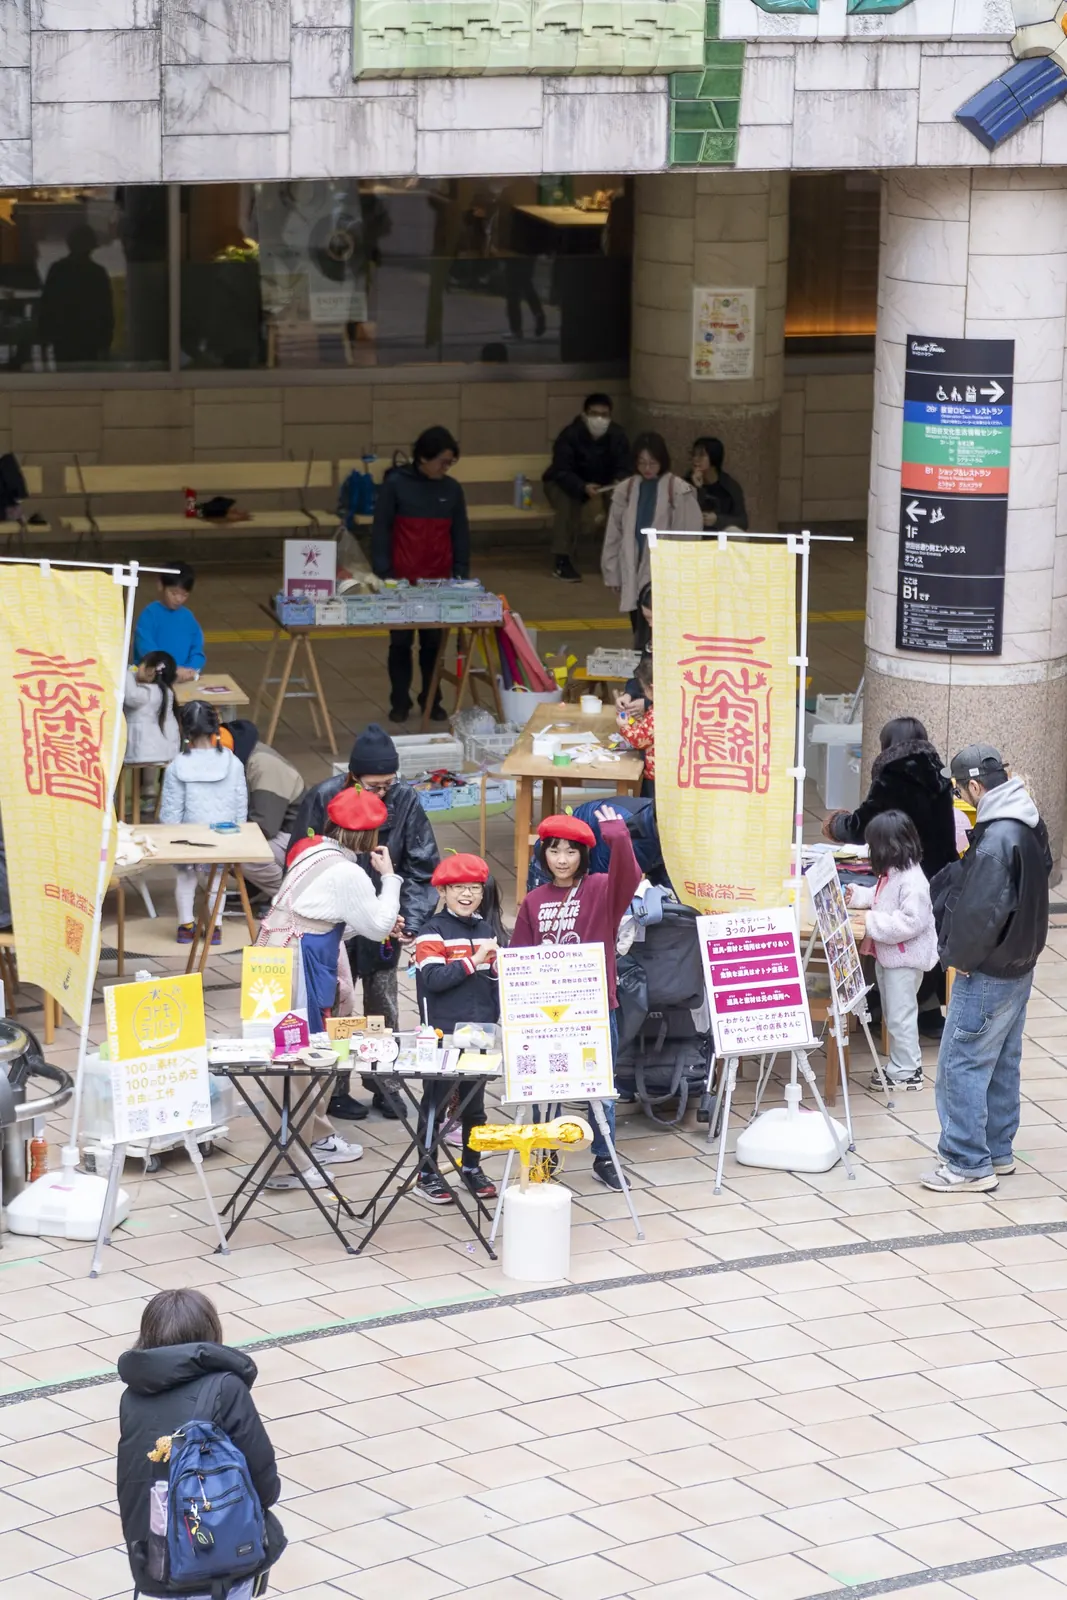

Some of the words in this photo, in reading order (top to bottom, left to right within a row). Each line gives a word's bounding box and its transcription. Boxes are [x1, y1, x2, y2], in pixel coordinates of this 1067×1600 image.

[975, 407, 1003, 415] レストラン
[925, 467, 933, 475] B1
[905, 525, 918, 538] 1F
[904, 556, 923, 564] オフィス
[904, 576, 918, 585] ここは
[902, 585, 918, 600] B1
[919, 593, 930, 601] です
[725, 924, 777, 936] 3つのルール
[251, 965, 286, 975] ¥1,000
[540, 966, 560, 974] PayPay
[143, 1003, 172, 1021] コドモ
[726, 1011, 796, 1024] わからないことがあれば
[141, 1019, 177, 1039] デパート
[736, 1034, 788, 1044] 聞いてくださいね
